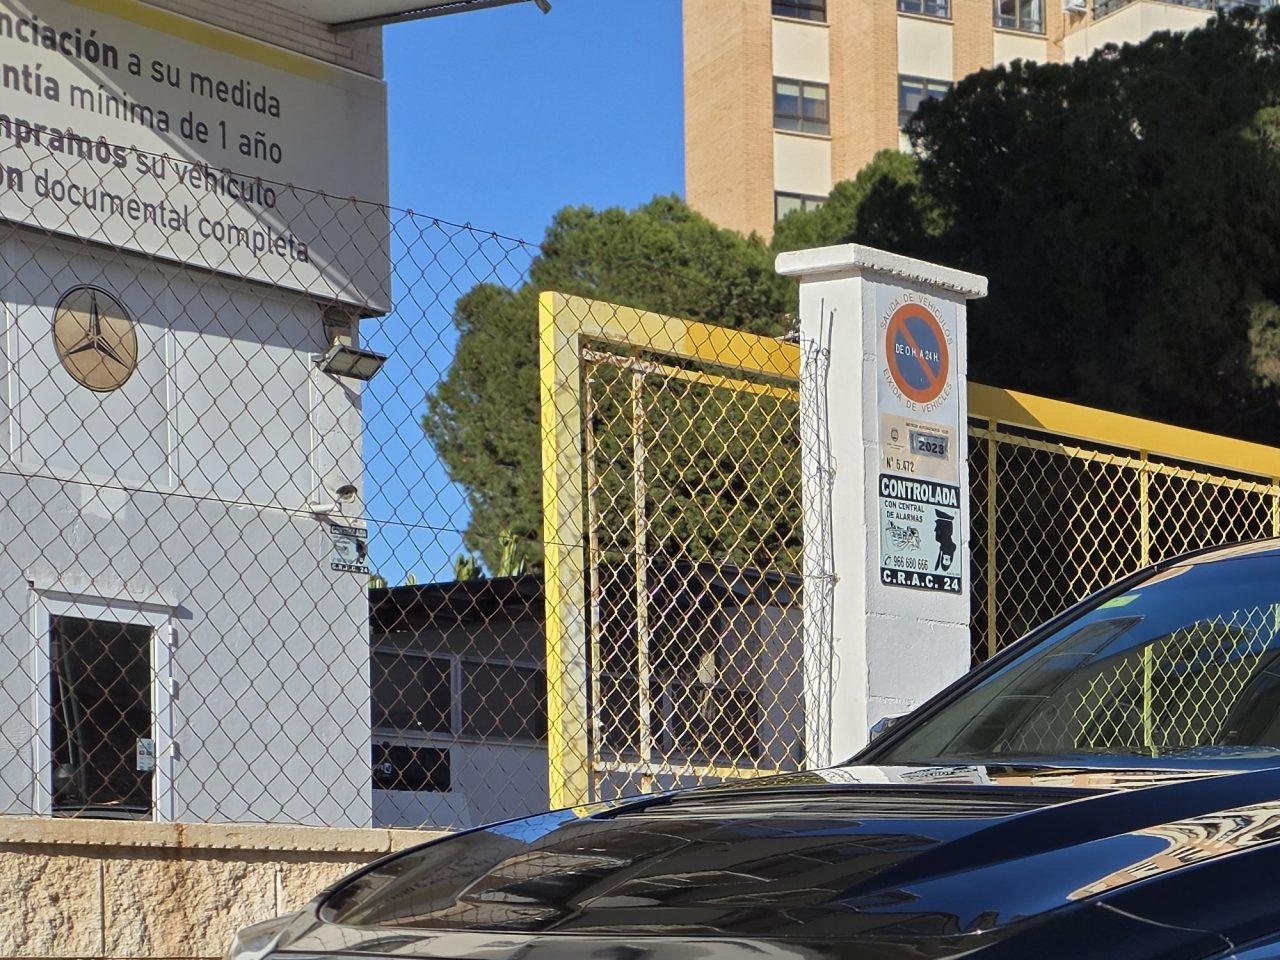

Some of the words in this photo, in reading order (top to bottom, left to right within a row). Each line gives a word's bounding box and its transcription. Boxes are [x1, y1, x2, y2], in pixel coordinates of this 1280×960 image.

[0, 12, 118, 70] nciación
[128, 53, 141, 76] a
[150, 60, 180, 89] su
[190, 71, 281, 118] medida
[2, 62, 60, 102] ntía
[70, 84, 169, 133] mínima
[180, 111, 209, 144] de
[218, 119, 226, 149] 1
[238, 131, 282, 164] año
[136, 152, 166, 180] su
[35, 168, 189, 232] documental
[198, 217, 308, 263] completa
[880, 299, 900, 330] SALIDA
[903, 292, 914, 302] DE
[895, 343, 904, 355] DE
[925, 350, 932, 361] 24
[883, 367, 902, 401] EIXIDA
[906, 400, 917, 412] DE
[921, 383, 952, 413] VEHICLES
[918, 440, 945, 456] 2023
[881, 477, 958, 507] CONTROLADA
[884, 500, 897, 509] CON
[898, 502, 925, 513] CENTRAL
[886, 510, 894, 519] DE
[895, 512, 923, 523] ALARMAS
[883, 569, 939, 589] C.R.A.C.
[943, 576, 959, 591] 24
